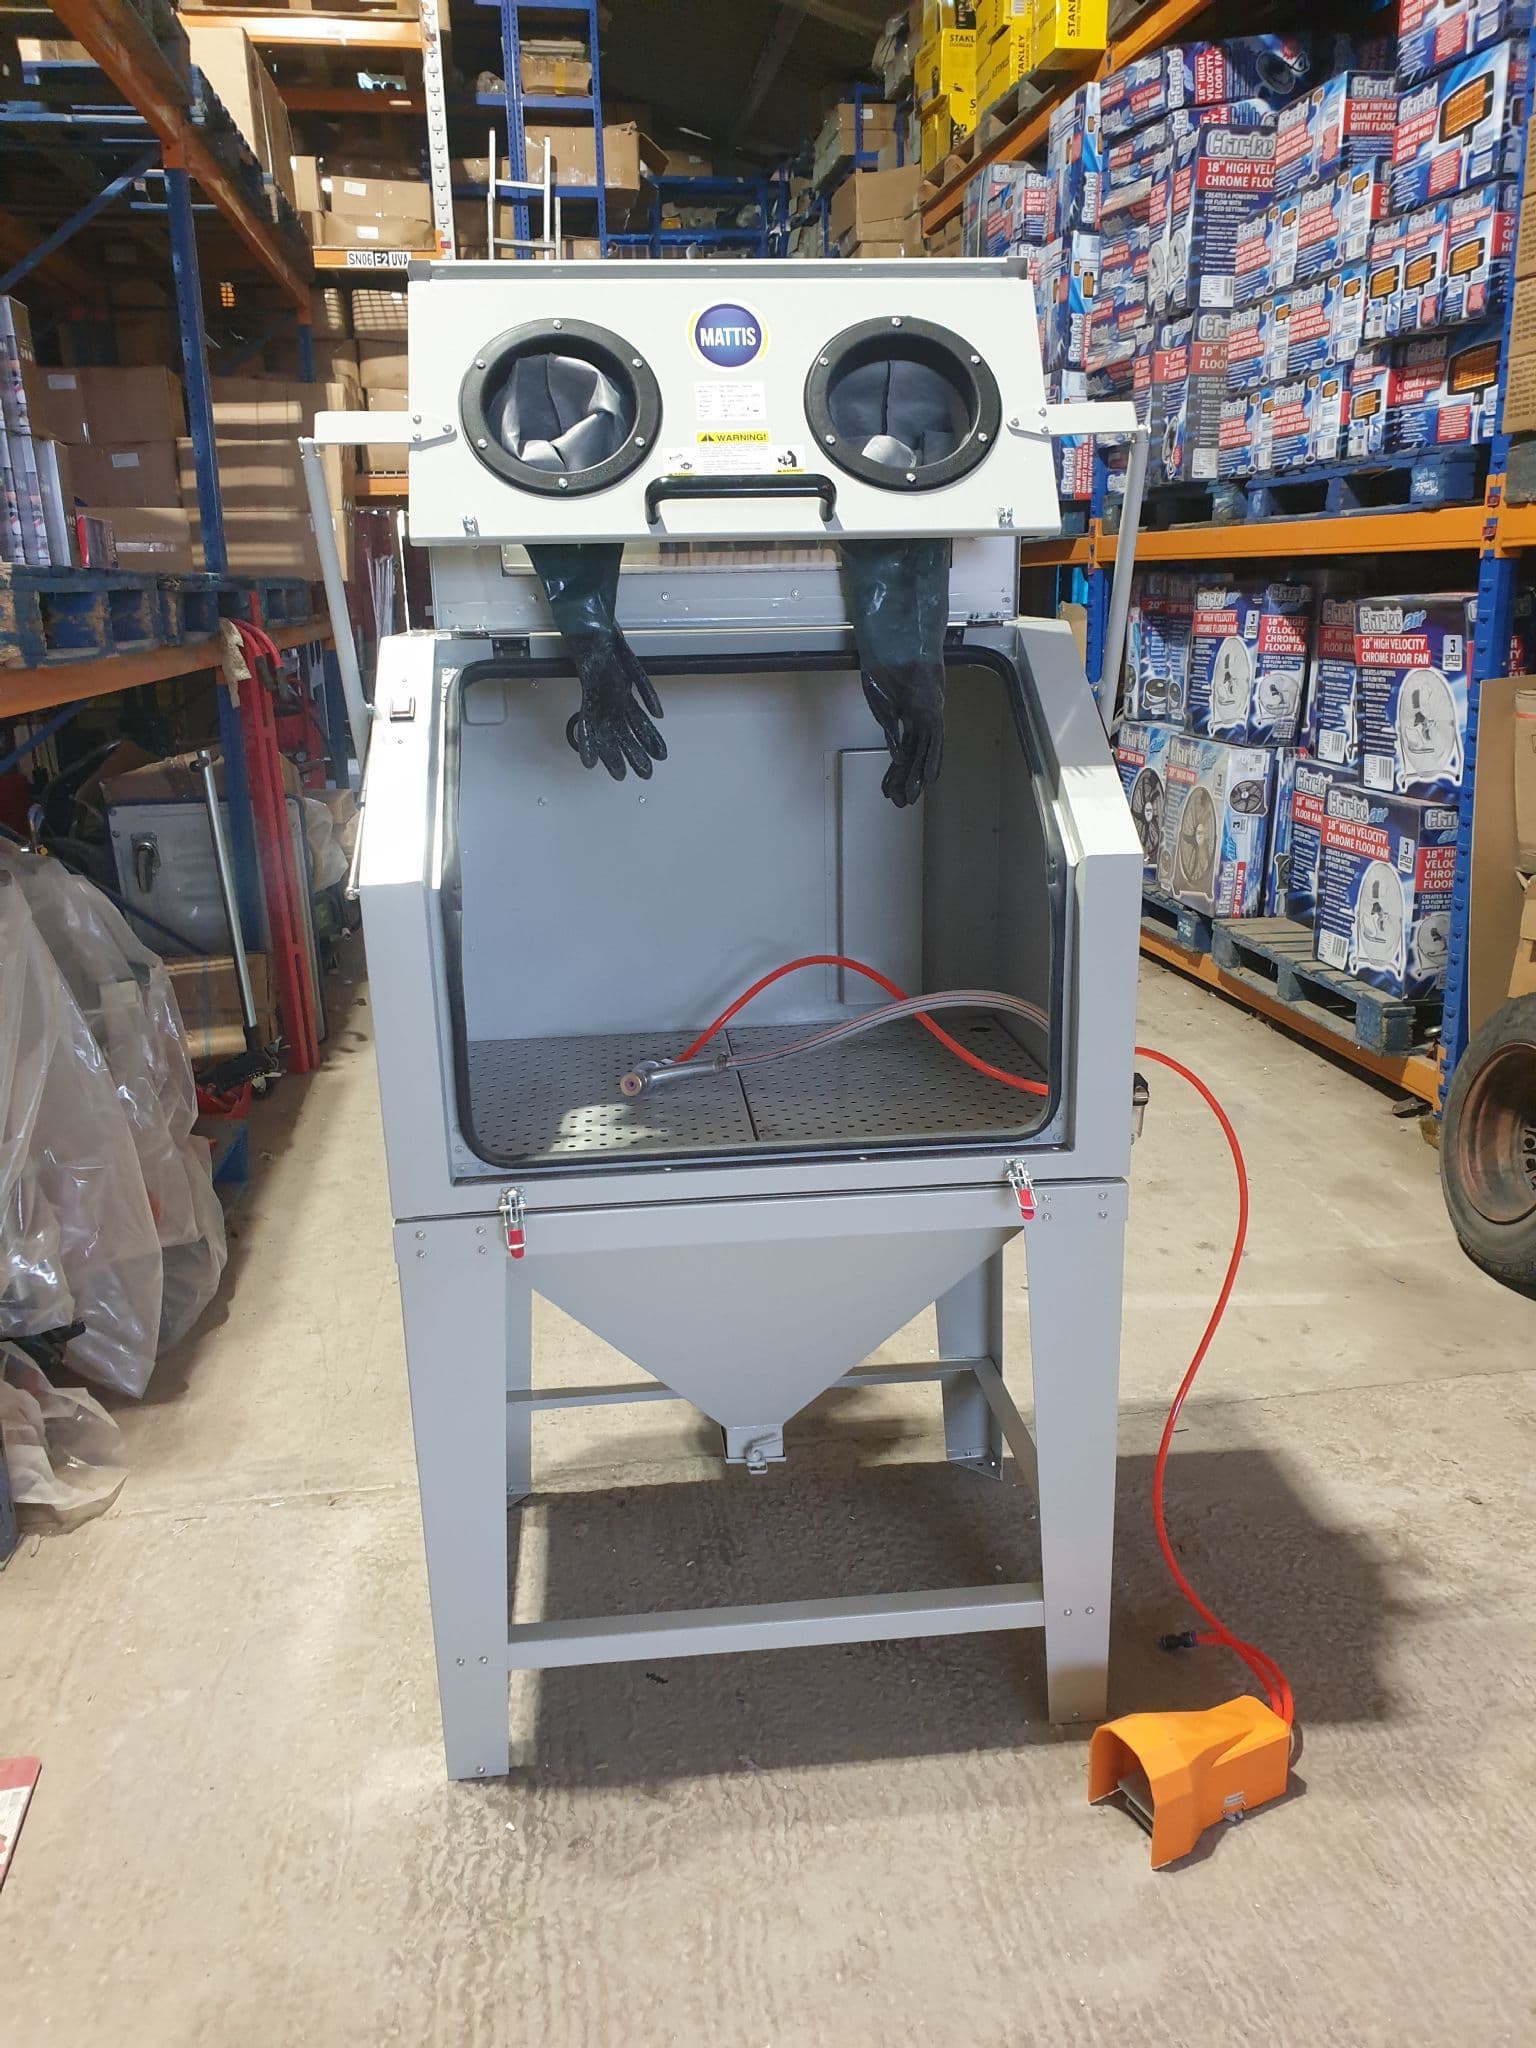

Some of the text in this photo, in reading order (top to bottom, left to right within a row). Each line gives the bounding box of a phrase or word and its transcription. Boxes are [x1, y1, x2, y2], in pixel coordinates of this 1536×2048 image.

[1207, 161, 1225, 173] 18"
[1226, 163, 1251, 174] HIGH
[1206, 175, 1249, 187] CHROME
[349, 253, 373, 265] SN06
[700, 327, 756, 347] MATTIS
[1403, 389, 1424, 400] HEATER
[717, 433, 767, 442] WARNING!
[1266, 626, 1306, 635] VELOCITY
[1265, 635, 1300, 643] CHROME
[1362, 637, 1426, 650] 18" HIGH VELOCITY
[1264, 643, 1291, 651] FLOOR
[1450, 639, 1456, 652] 3
[1362, 651, 1429, 665] CHROME FLOOR FAN
[1295, 807, 1310, 819] FLOOR
[1328, 819, 1387, 844] 18" HIGH VELOCITY
[1326, 832, 1355, 848] CHROME
[1355, 839, 1375, 854] FLOOR
[1376, 846, 1389, 859] FAN
[1404, 842, 1409, 854] 3
[1426, 849, 1443, 858] 18"
[1423, 880, 1455, 889] FLOOR
[1234, 885, 1242, 900] BOX
